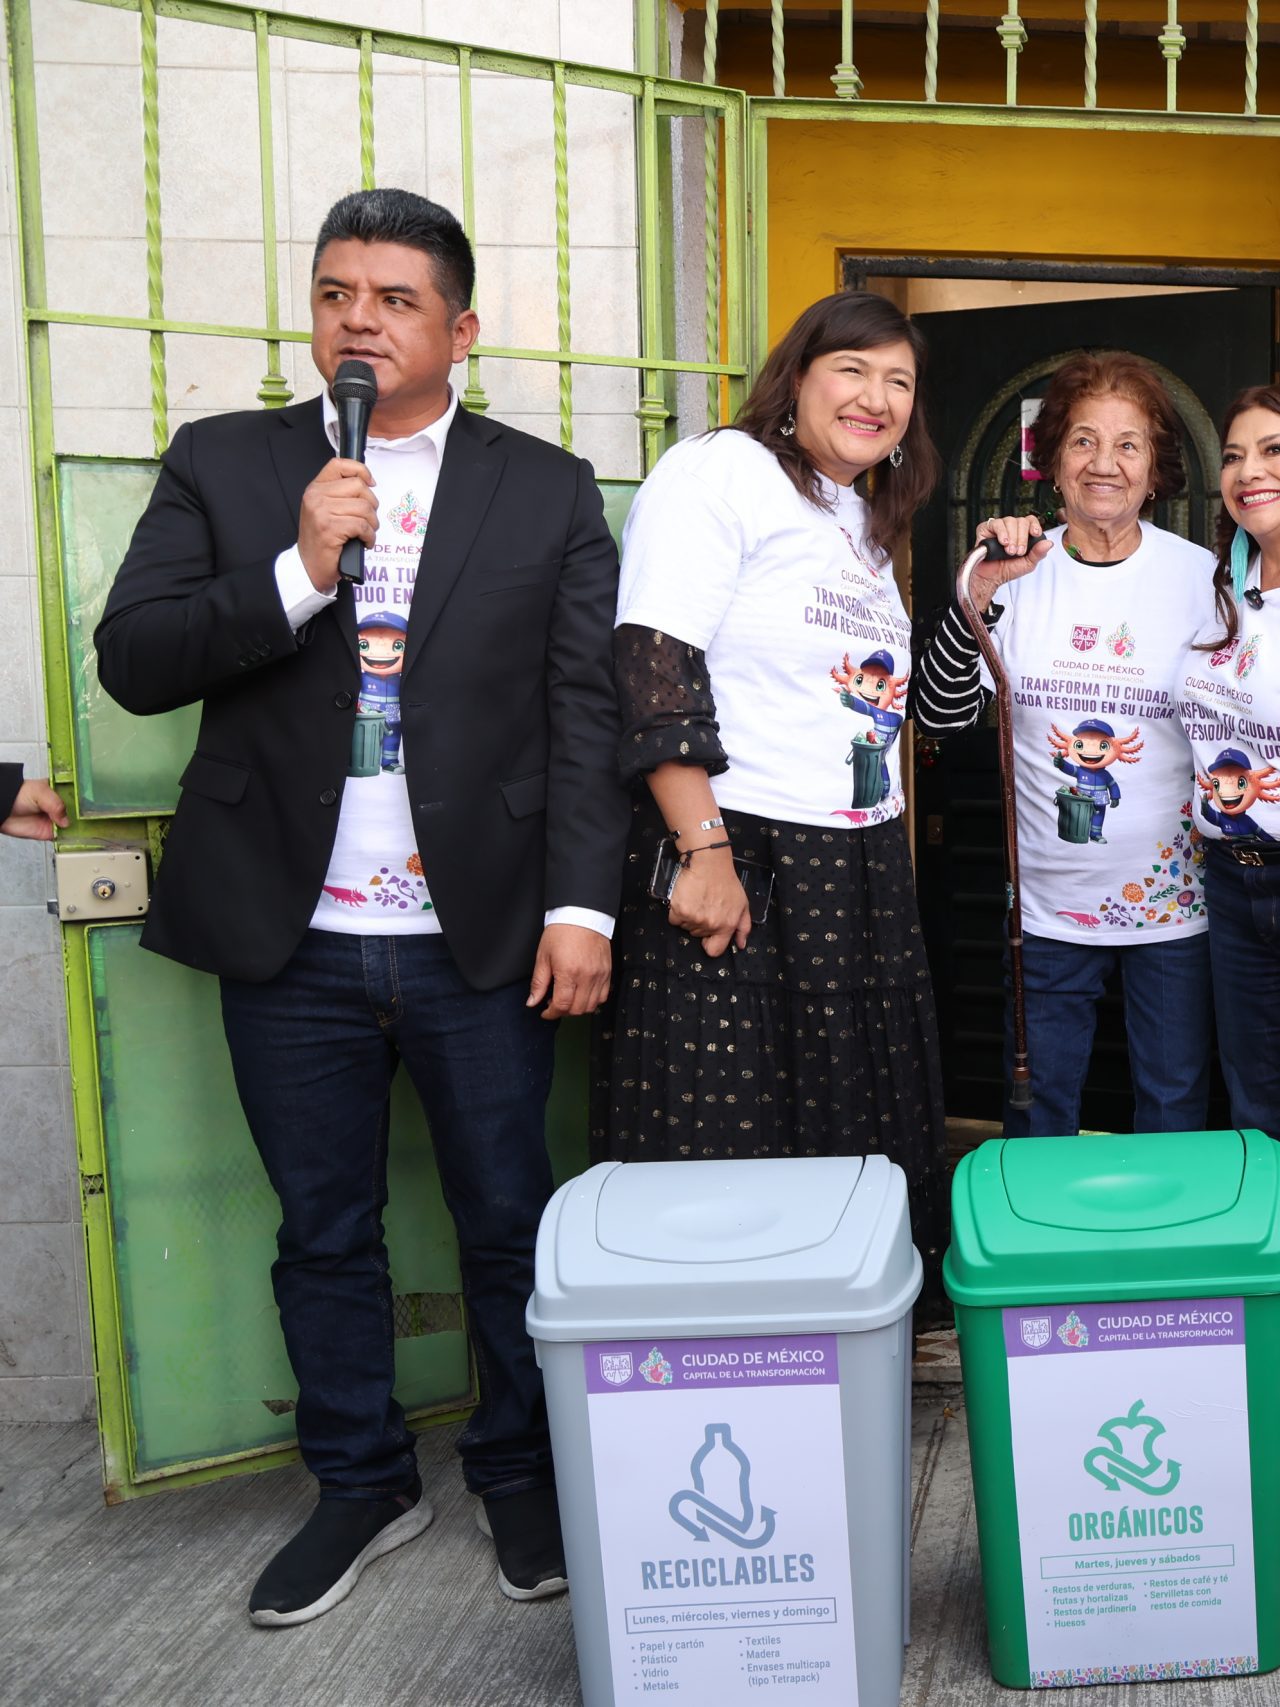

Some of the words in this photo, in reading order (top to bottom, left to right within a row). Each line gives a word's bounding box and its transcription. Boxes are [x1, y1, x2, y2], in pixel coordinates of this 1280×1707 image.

[374, 545, 391, 553] DE
[396, 568, 416, 583] TU
[842, 570, 870, 588] CIUDAD
[393, 588, 413, 604] EN
[805, 606, 837, 630] CADA
[841, 616, 881, 642] RESIDUO
[881, 628, 895, 645] EN
[1053, 660, 1089, 671] CIUDAD
[1092, 663, 1105, 672] DE
[1107, 664, 1144, 676] MÉXICO
[1021, 676, 1100, 697] TRANSFORMA
[1107, 684, 1119, 698] TU
[1124, 686, 1171, 707] CIUDAD,
[1185, 676, 1215, 692] CIUDAD
[1216, 684, 1225, 696] DE
[1227, 689, 1253, 704] MÉXICO
[1014, 692, 1042, 708] CADA
[1047, 696, 1096, 713] RESIDUO
[1101, 701, 1115, 714] EN
[1120, 704, 1135, 716] SU
[1139, 706, 1175, 719] LUGAR
[1222, 712, 1235, 732] TU
[1098, 1315, 1152, 1329] CIUDAD
[1156, 1314, 1174, 1326] DE
[1178, 1310, 1232, 1325] MÉXICO
[1099, 1333, 1130, 1343] CAPITAL
[1133, 1332, 1144, 1340] DE
[1146, 1331, 1156, 1340] LA
[1158, 1328, 1233, 1339] TRANSFORMACIÓN
[682, 1353, 739, 1366] CIUDAD
[744, 1352, 763, 1364] DE
[768, 1348, 824, 1364] MÉXICO
[683, 1370, 717, 1380] CAPITAL
[720, 1370, 731, 1379] DE
[733, 1370, 744, 1378] LA
[746, 1366, 825, 1378] TRANSFORMACIÓN
[1069, 1505, 1204, 1541] ORGÁNICOS
[1075, 1559, 1113, 1569] Martes,
[1115, 1557, 1148, 1568] jueves
[1150, 1558, 1156, 1566] y
[1159, 1553, 1201, 1564] sábados
[641, 1553, 815, 1590] RECICLABLES
[1053, 1585, 1081, 1594] Restos
[1084, 1584, 1094, 1592] de
[1096, 1581, 1135, 1592] verduras,
[1149, 1578, 1178, 1588] Restos
[1181, 1577, 1191, 1585] de
[1193, 1575, 1211, 1584] café
[1213, 1576, 1218, 1585] y
[1220, 1574, 1228, 1583] té
[1053, 1596, 1078, 1606] frutas
[1080, 1596, 1085, 1604] y
[1087, 1593, 1128, 1604] hortalizas
[1150, 1589, 1194, 1599] Servilletas
[1196, 1588, 1211, 1596] con
[1053, 1608, 1082, 1617] Restos
[1084, 1606, 1095, 1615] de
[1097, 1604, 1136, 1615] jardinería
[1150, 1601, 1176, 1610] restos
[1179, 1600, 1189, 1608] de
[1191, 1598, 1222, 1607] comida
[632, 1612, 669, 1625] Lunes,
[672, 1610, 728, 1623] miércoles,
[731, 1608, 770, 1619] viernes
[773, 1609, 779, 1619] y
[782, 1605, 830, 1617] domingo
[1054, 1618, 1086, 1628] Huesos
[640, 1641, 665, 1653] Papel
[668, 1643, 673, 1651] y
[676, 1639, 704, 1649] cartón
[745, 1636, 781, 1646] Textiles
[641, 1655, 678, 1665] Plástico
[747, 1650, 780, 1659] Madera
[642, 1668, 669, 1678] Vidrio
[748, 1662, 784, 1672] Envases
[787, 1659, 831, 1671] multicapa
[643, 1681, 679, 1691] Metales
[748, 1675, 769, 1687] (tipo
[772, 1672, 820, 1684] Tetrapack)
